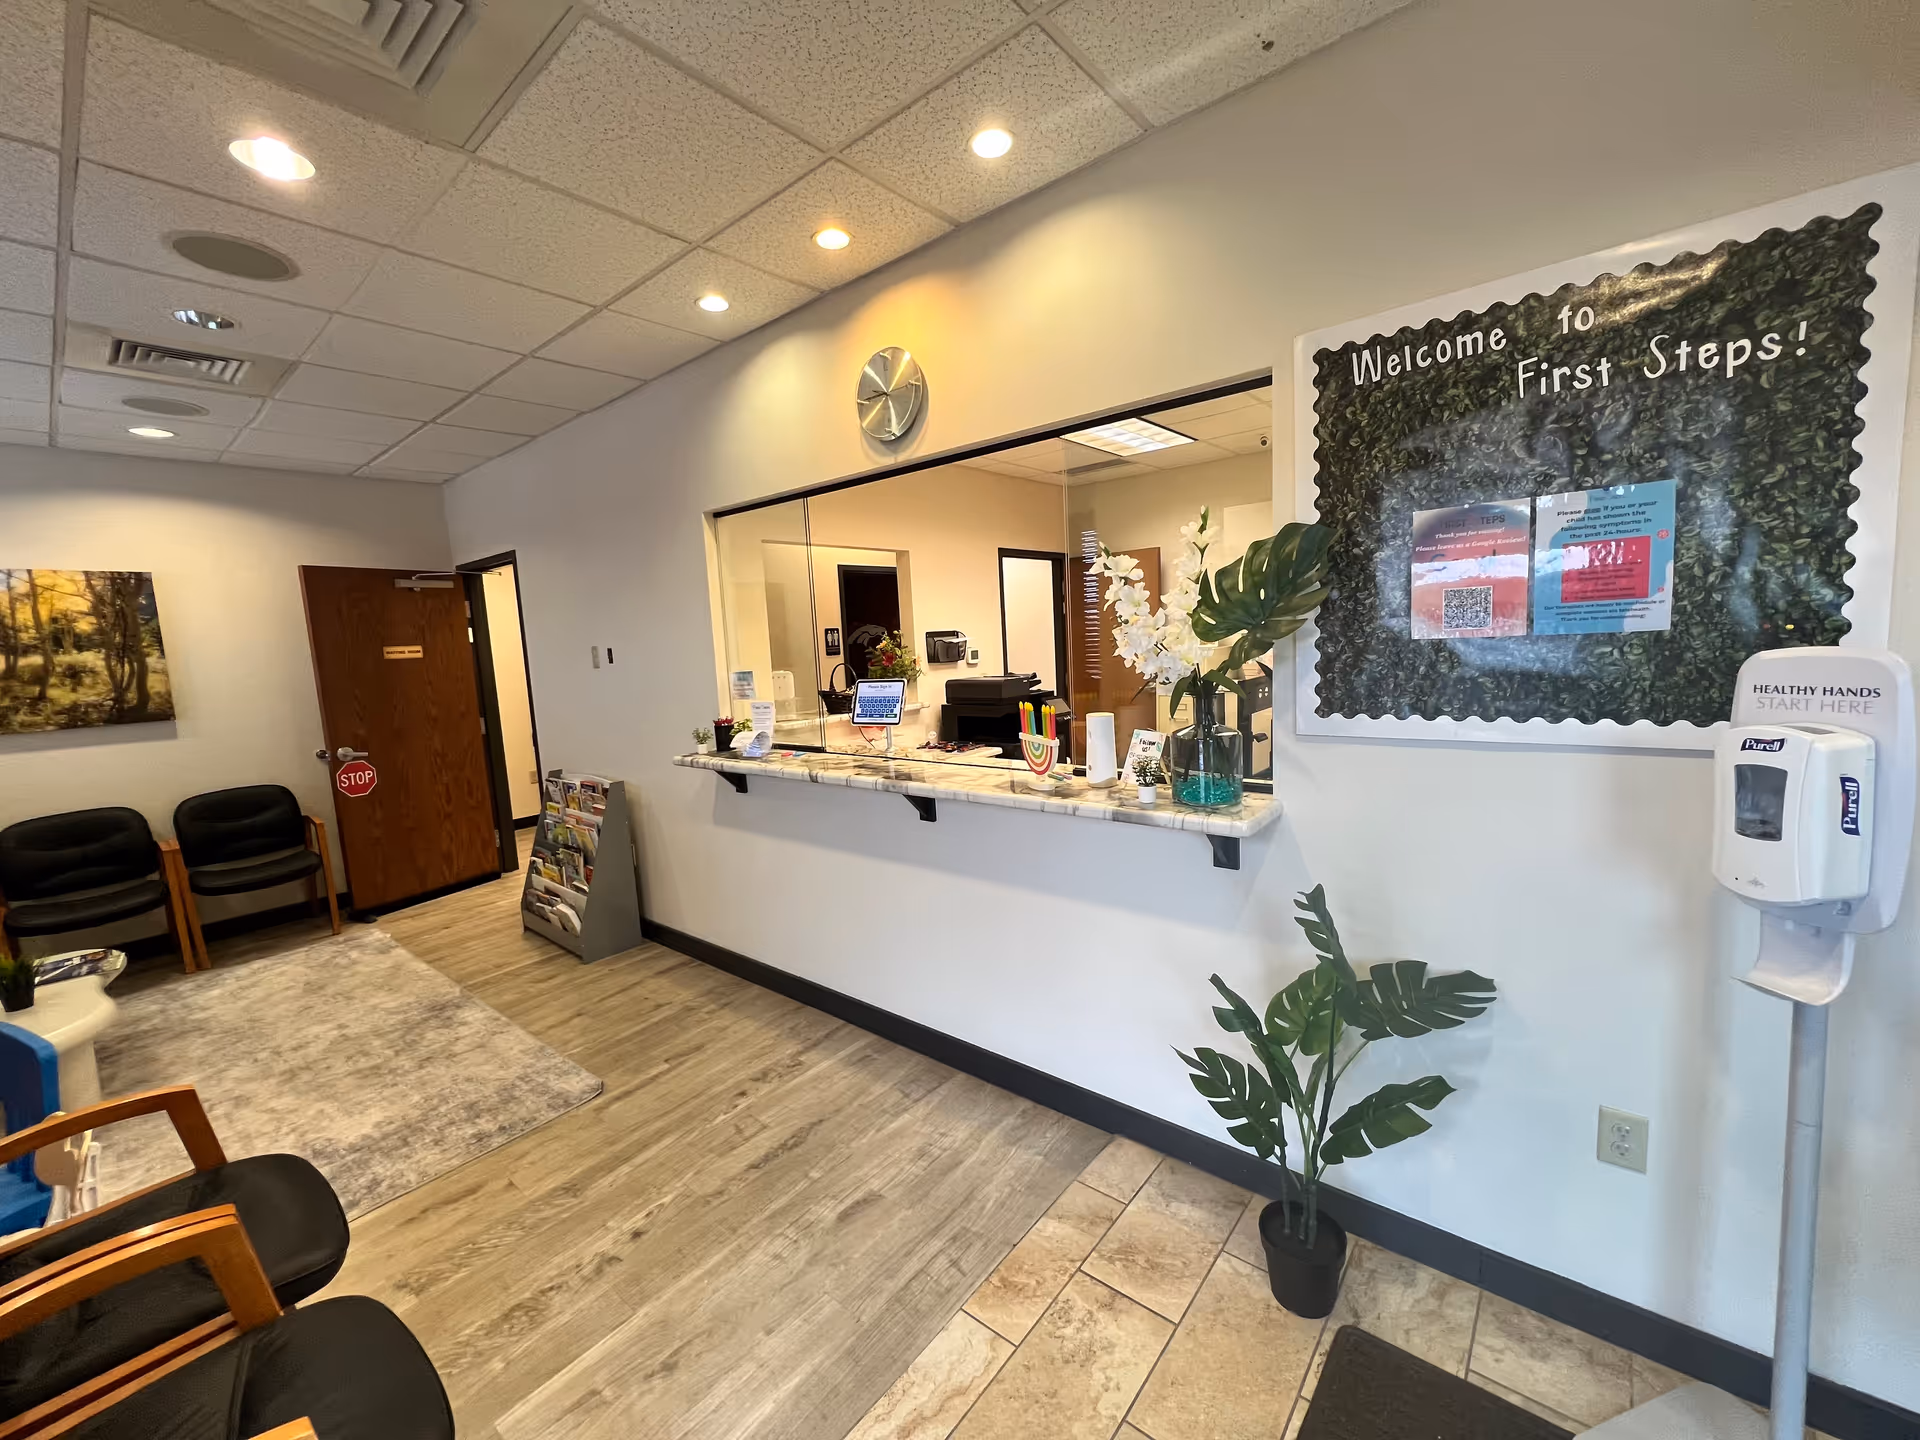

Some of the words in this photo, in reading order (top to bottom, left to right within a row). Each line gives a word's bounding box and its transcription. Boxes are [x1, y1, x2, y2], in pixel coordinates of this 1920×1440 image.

[1352, 327, 1507, 386] Welcome
[1557, 304, 1595, 334] to
[1517, 356, 1611, 398] First
[1643, 320, 1808, 379] Steps!
[1638, 500, 1658, 508] your
[1566, 515, 1586, 523] child
[1587, 514, 1601, 522] has
[1602, 512, 1631, 520] shown
[1560, 523, 1598, 532] following
[1599, 519, 1642, 528] symptoms
[1435, 532, 1455, 540] Thank
[1454, 531, 1467, 539] you
[1472, 539, 1496, 547] Google
[1496, 535, 1527, 544] Review!
[1584, 531, 1601, 539] past
[1753, 684, 1818, 696] HEALTHY
[1822, 686, 1882, 698] HANDS
[1757, 697, 1813, 711] START
[1820, 699, 1875, 715] HERE
[340, 770, 374, 787] STOP
